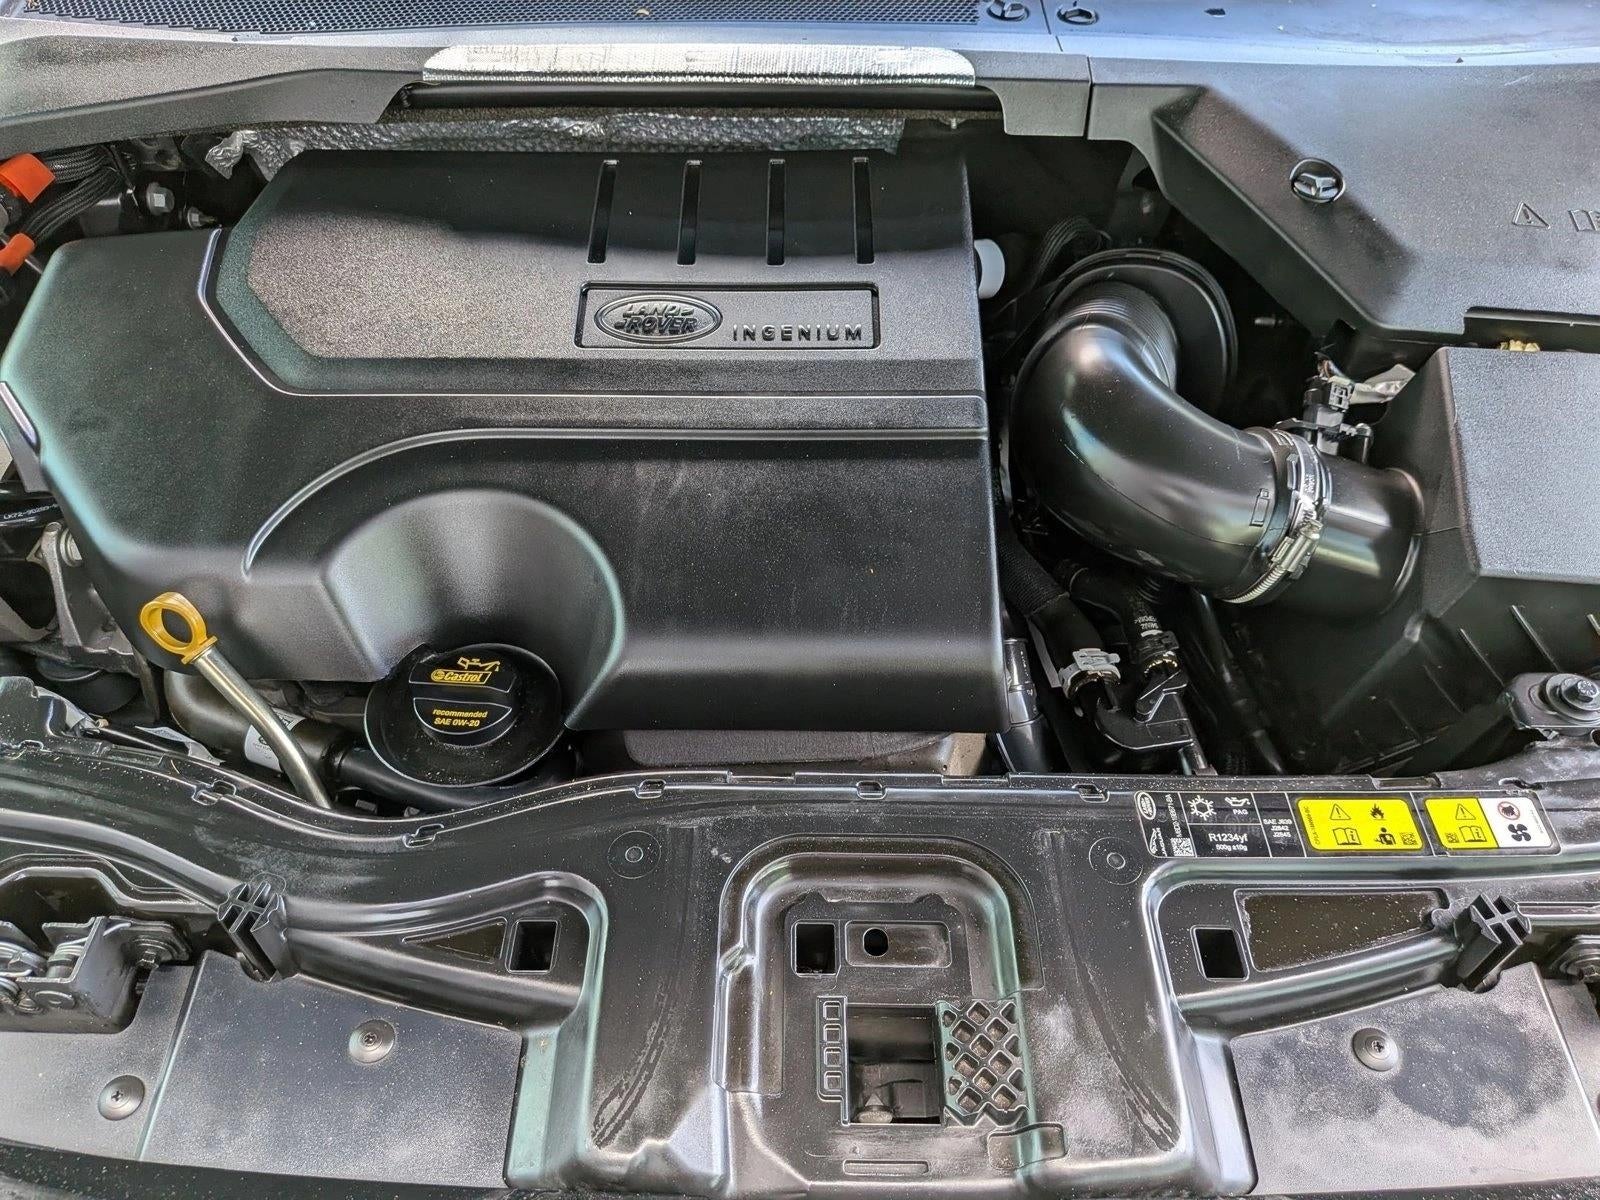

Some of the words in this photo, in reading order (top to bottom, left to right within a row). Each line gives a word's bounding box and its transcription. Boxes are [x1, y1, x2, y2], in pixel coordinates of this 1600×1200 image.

[622, 303, 688, 318] LAND
[621, 317, 700, 334] ROVER
[732, 324, 862, 341] INGENIUM
[444, 671, 483, 682] Castrol
[432, 709, 488, 718] recommended
[434, 717, 452, 726] SAE
[452, 718, 480, 727] 0W-20
[1208, 833, 1248, 843] R1234yf
